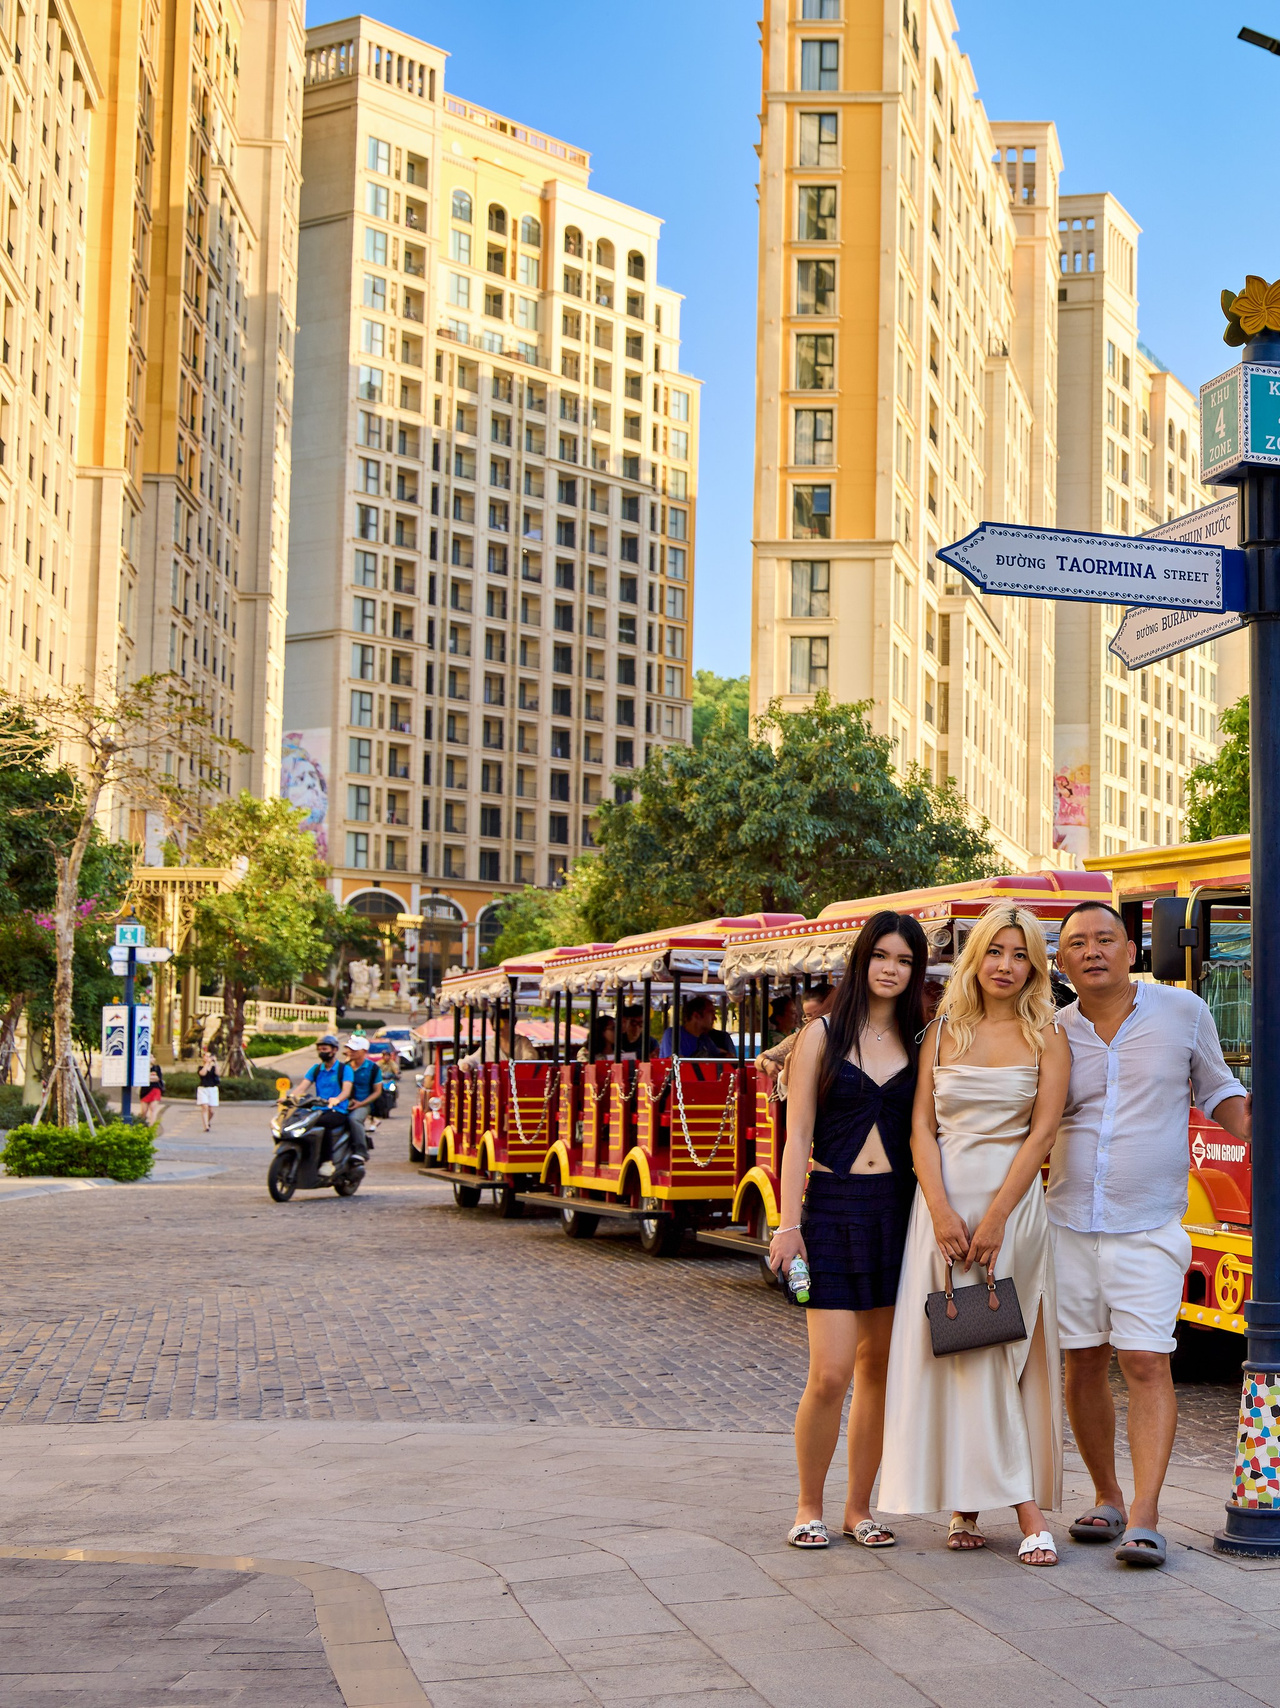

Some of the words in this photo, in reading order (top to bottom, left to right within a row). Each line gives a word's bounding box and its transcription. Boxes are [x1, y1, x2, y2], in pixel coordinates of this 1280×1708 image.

[1210, 385, 1230, 408] KHU
[1215, 407, 1226, 439] 4
[1209, 438, 1232, 463] ZONE
[1205, 513, 1231, 539] NƯỚC
[995, 553, 1046, 570] ĐƯỜNG
[1056, 555, 1157, 580] TAORMINA
[1163, 568, 1209, 583] STREET
[1136, 622, 1159, 640] ĐƯỜNG
[1206, 1143, 1221, 1160] SUN
[1221, 1144, 1246, 1162] GROUP
